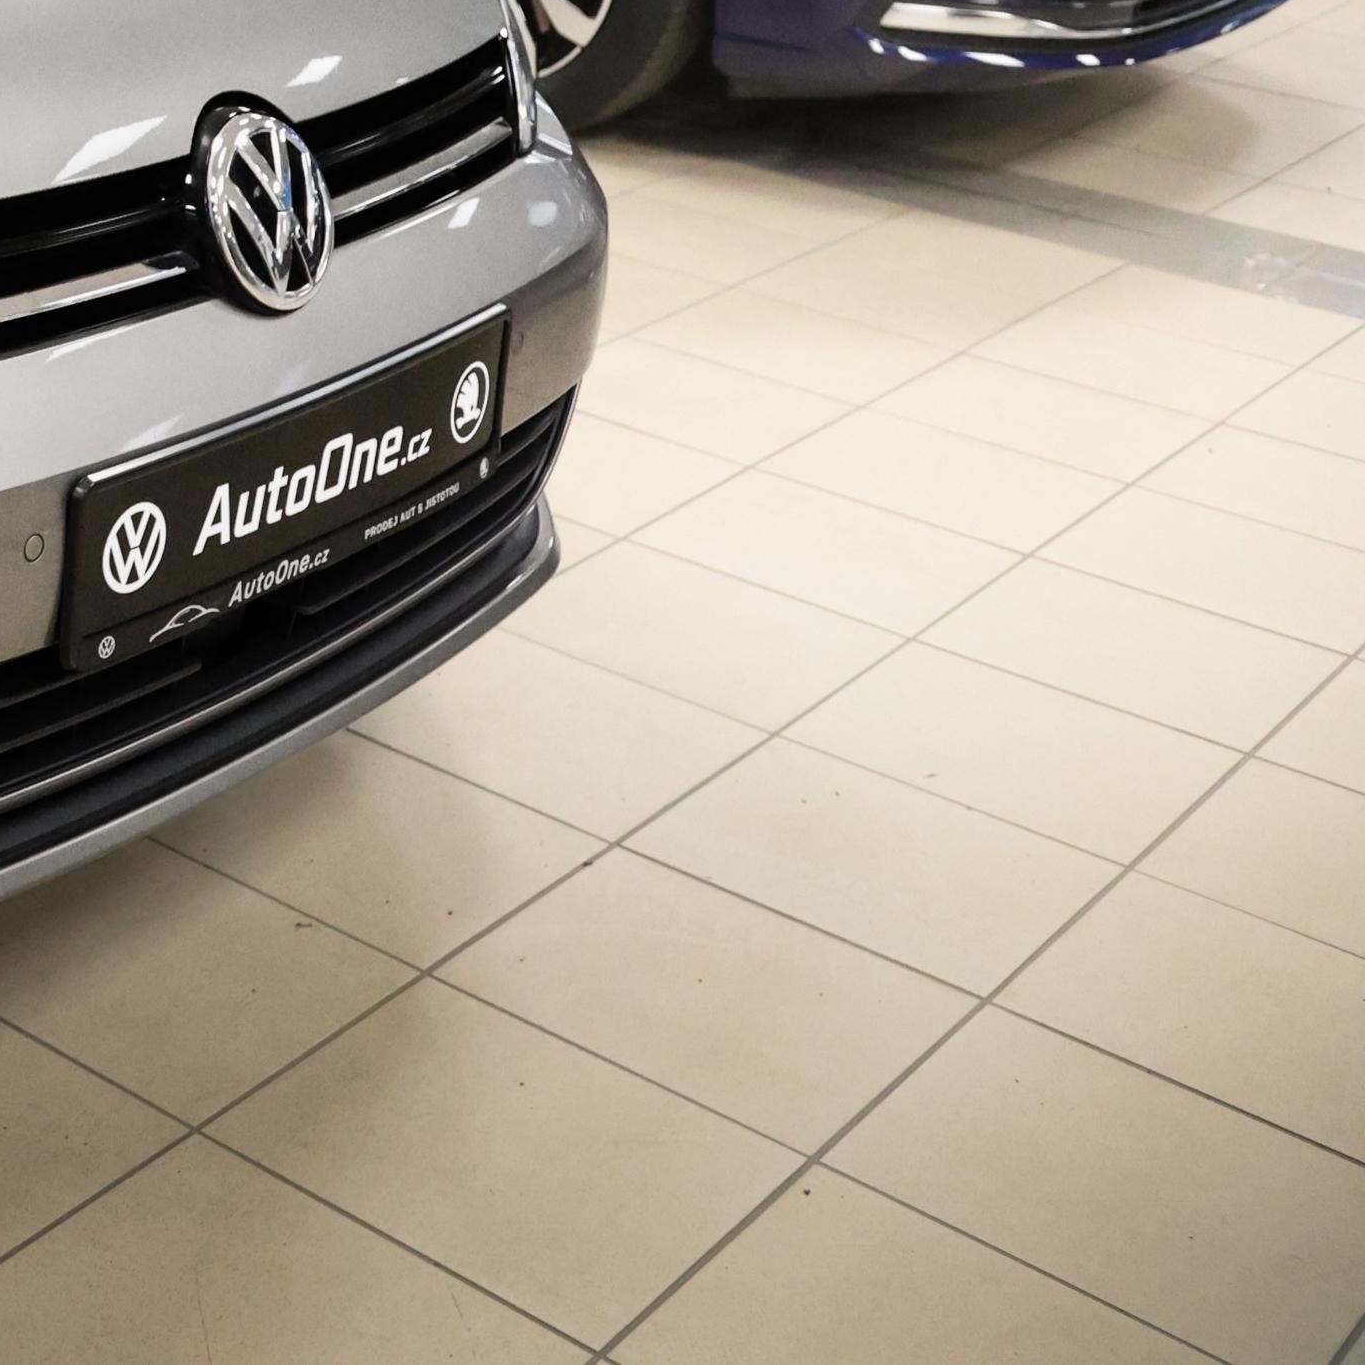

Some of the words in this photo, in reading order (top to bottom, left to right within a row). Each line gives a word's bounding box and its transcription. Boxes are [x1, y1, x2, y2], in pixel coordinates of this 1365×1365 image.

[192, 425, 433, 557] AutoOne.cz
[364, 515, 399, 541] PRODEJ
[400, 505, 417, 524] AUT
[424, 481, 460, 511] JISTOTOU
[227, 547, 331, 608] AutoOne.cz
